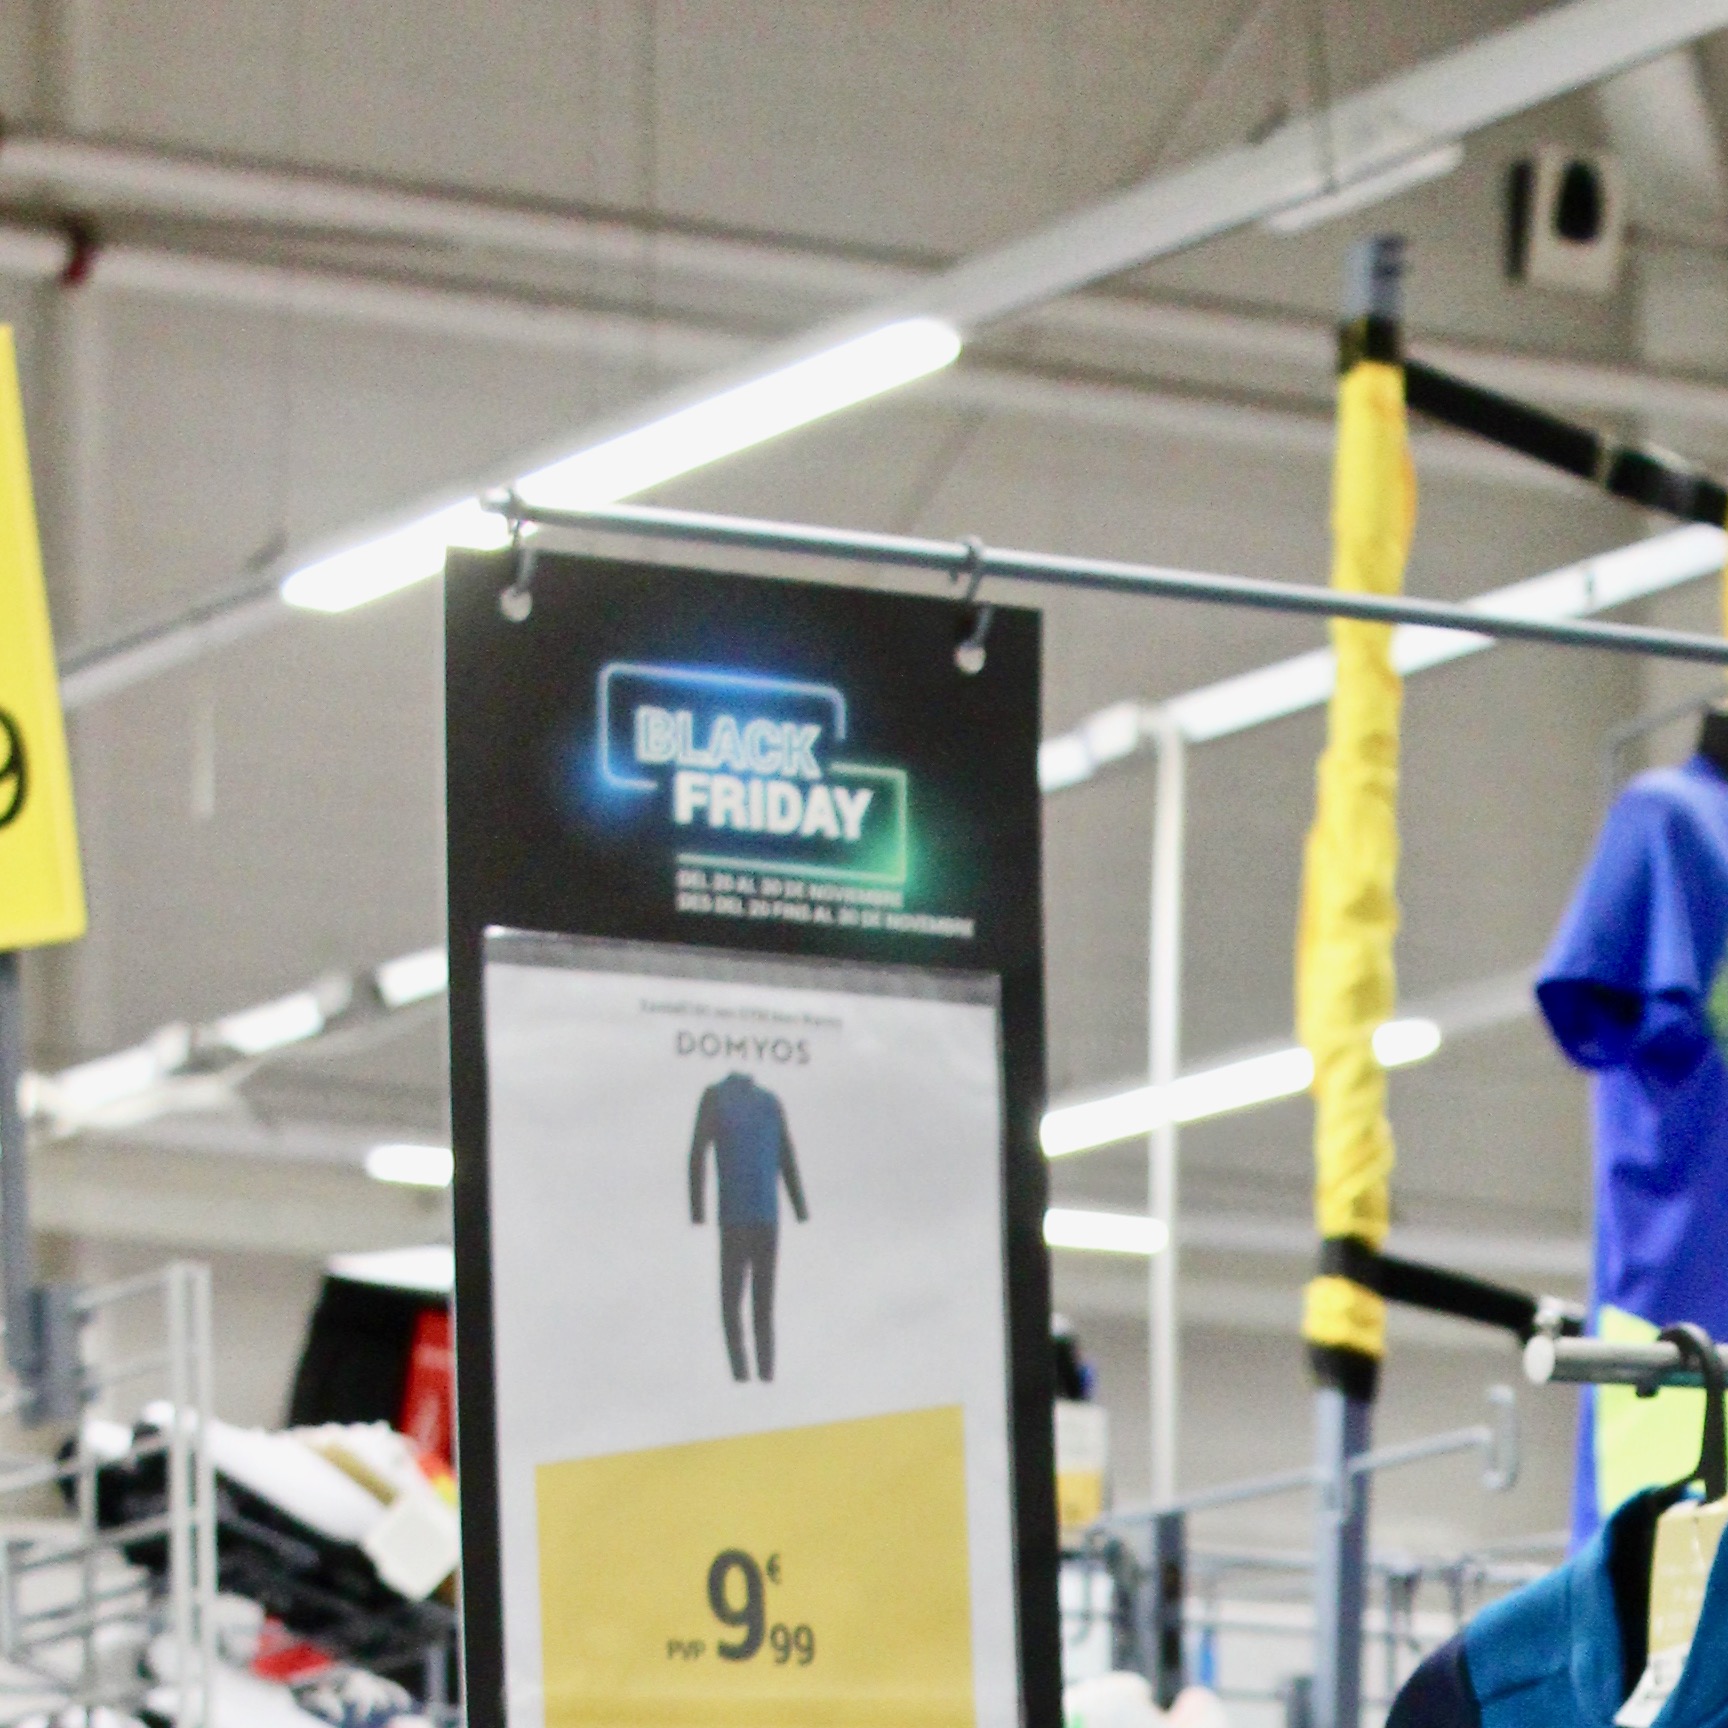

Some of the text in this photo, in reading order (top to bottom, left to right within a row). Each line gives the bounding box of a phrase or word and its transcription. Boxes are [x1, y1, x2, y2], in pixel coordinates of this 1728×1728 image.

[632, 703, 823, 778] BLACK
[672, 771, 874, 840] FRIDAY
[676, 1029, 812, 1066] DOMYOS
